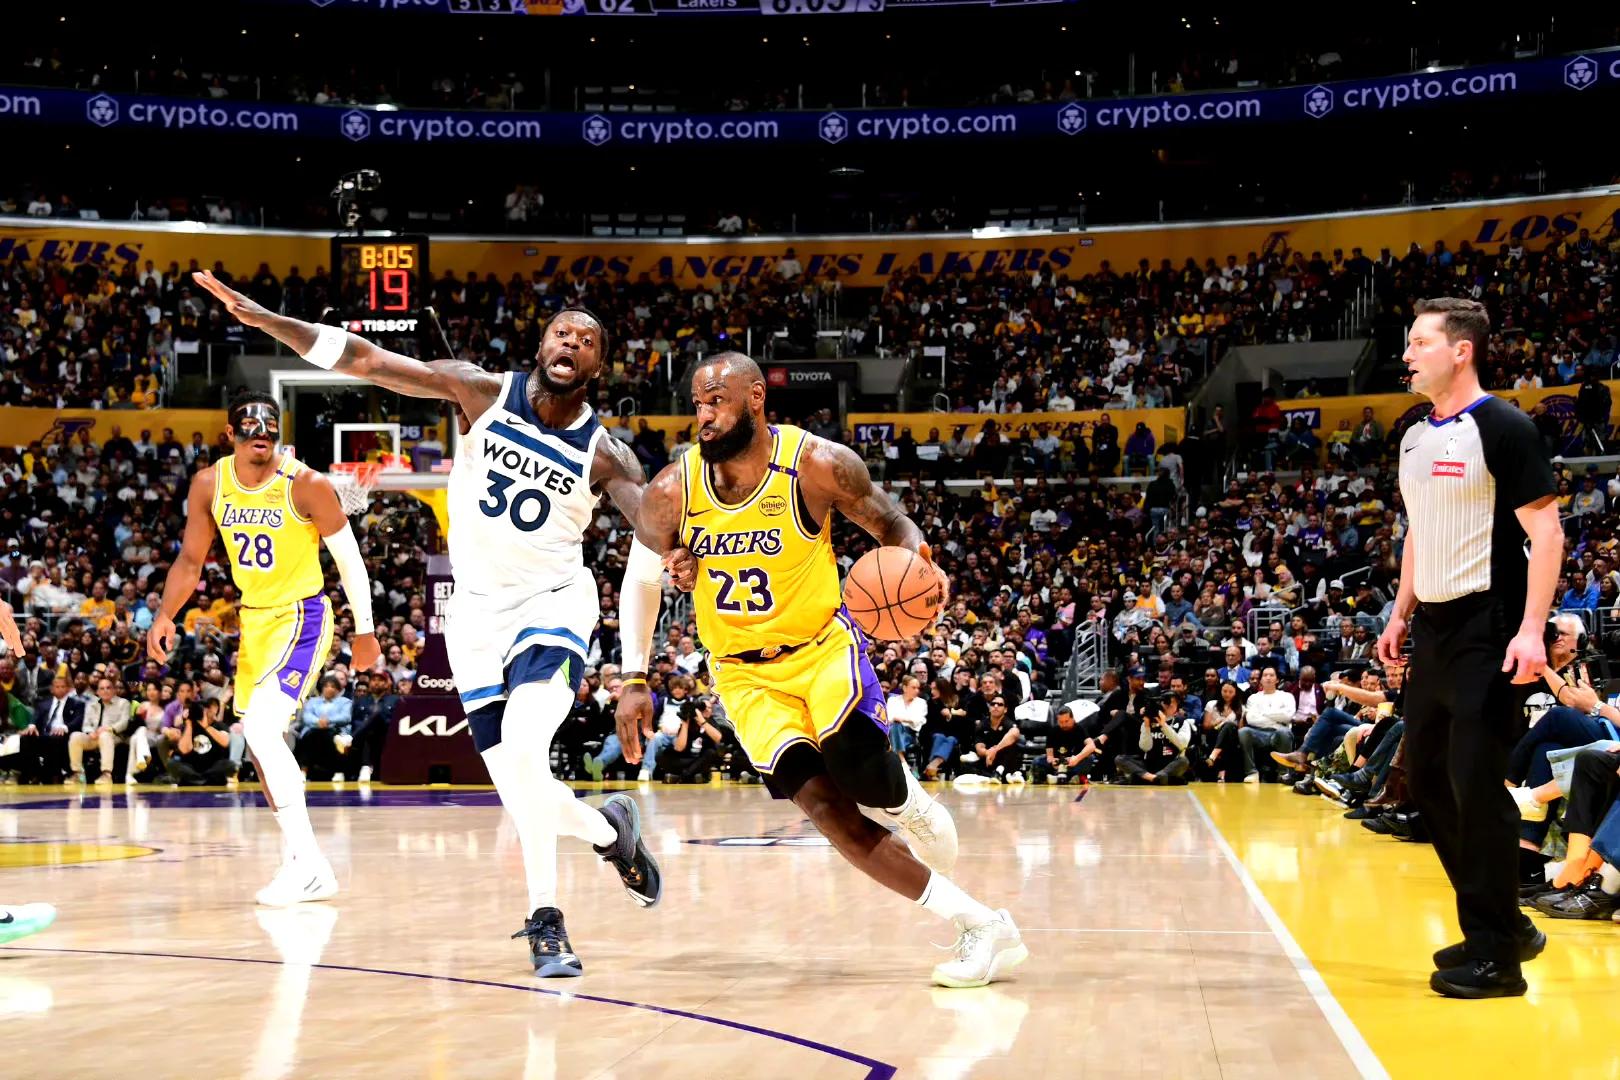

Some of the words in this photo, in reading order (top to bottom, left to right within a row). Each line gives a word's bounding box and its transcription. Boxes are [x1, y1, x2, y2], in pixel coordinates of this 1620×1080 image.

[1344, 68, 1516, 108] crypto.com
[129, 104, 298, 131] crypto.com
[857, 112, 1016, 140] crypto.com
[1096, 98, 1261, 128] crypto.com
[380, 116, 541, 141] crypto.com
[620, 118, 778, 143] crypto.com
[1473, 211, 1582, 243] LOS
[361, 245, 413, 269] 8:05
[540, 255, 633, 277] LOS
[650, 253, 863, 278] ANGEES
[876, 246, 1075, 276] LAKERS
[370, 270, 408, 311] 19
[362, 319, 418, 332] TISSOT
[789, 371, 832, 381] TOYOTA
[400, 425, 420, 439] 06
[483, 438, 576, 496] WOLVES
[1432, 463, 1464, 474] Emirates
[478, 469, 551, 532] 30
[761, 500, 786, 510] bibigo
[220, 503, 283, 528] LAKERS
[233, 532, 274, 568] 28
[688, 526, 783, 557] LAKERS
[707, 566, 774, 613] 23
[418, 675, 456, 691] Goog
